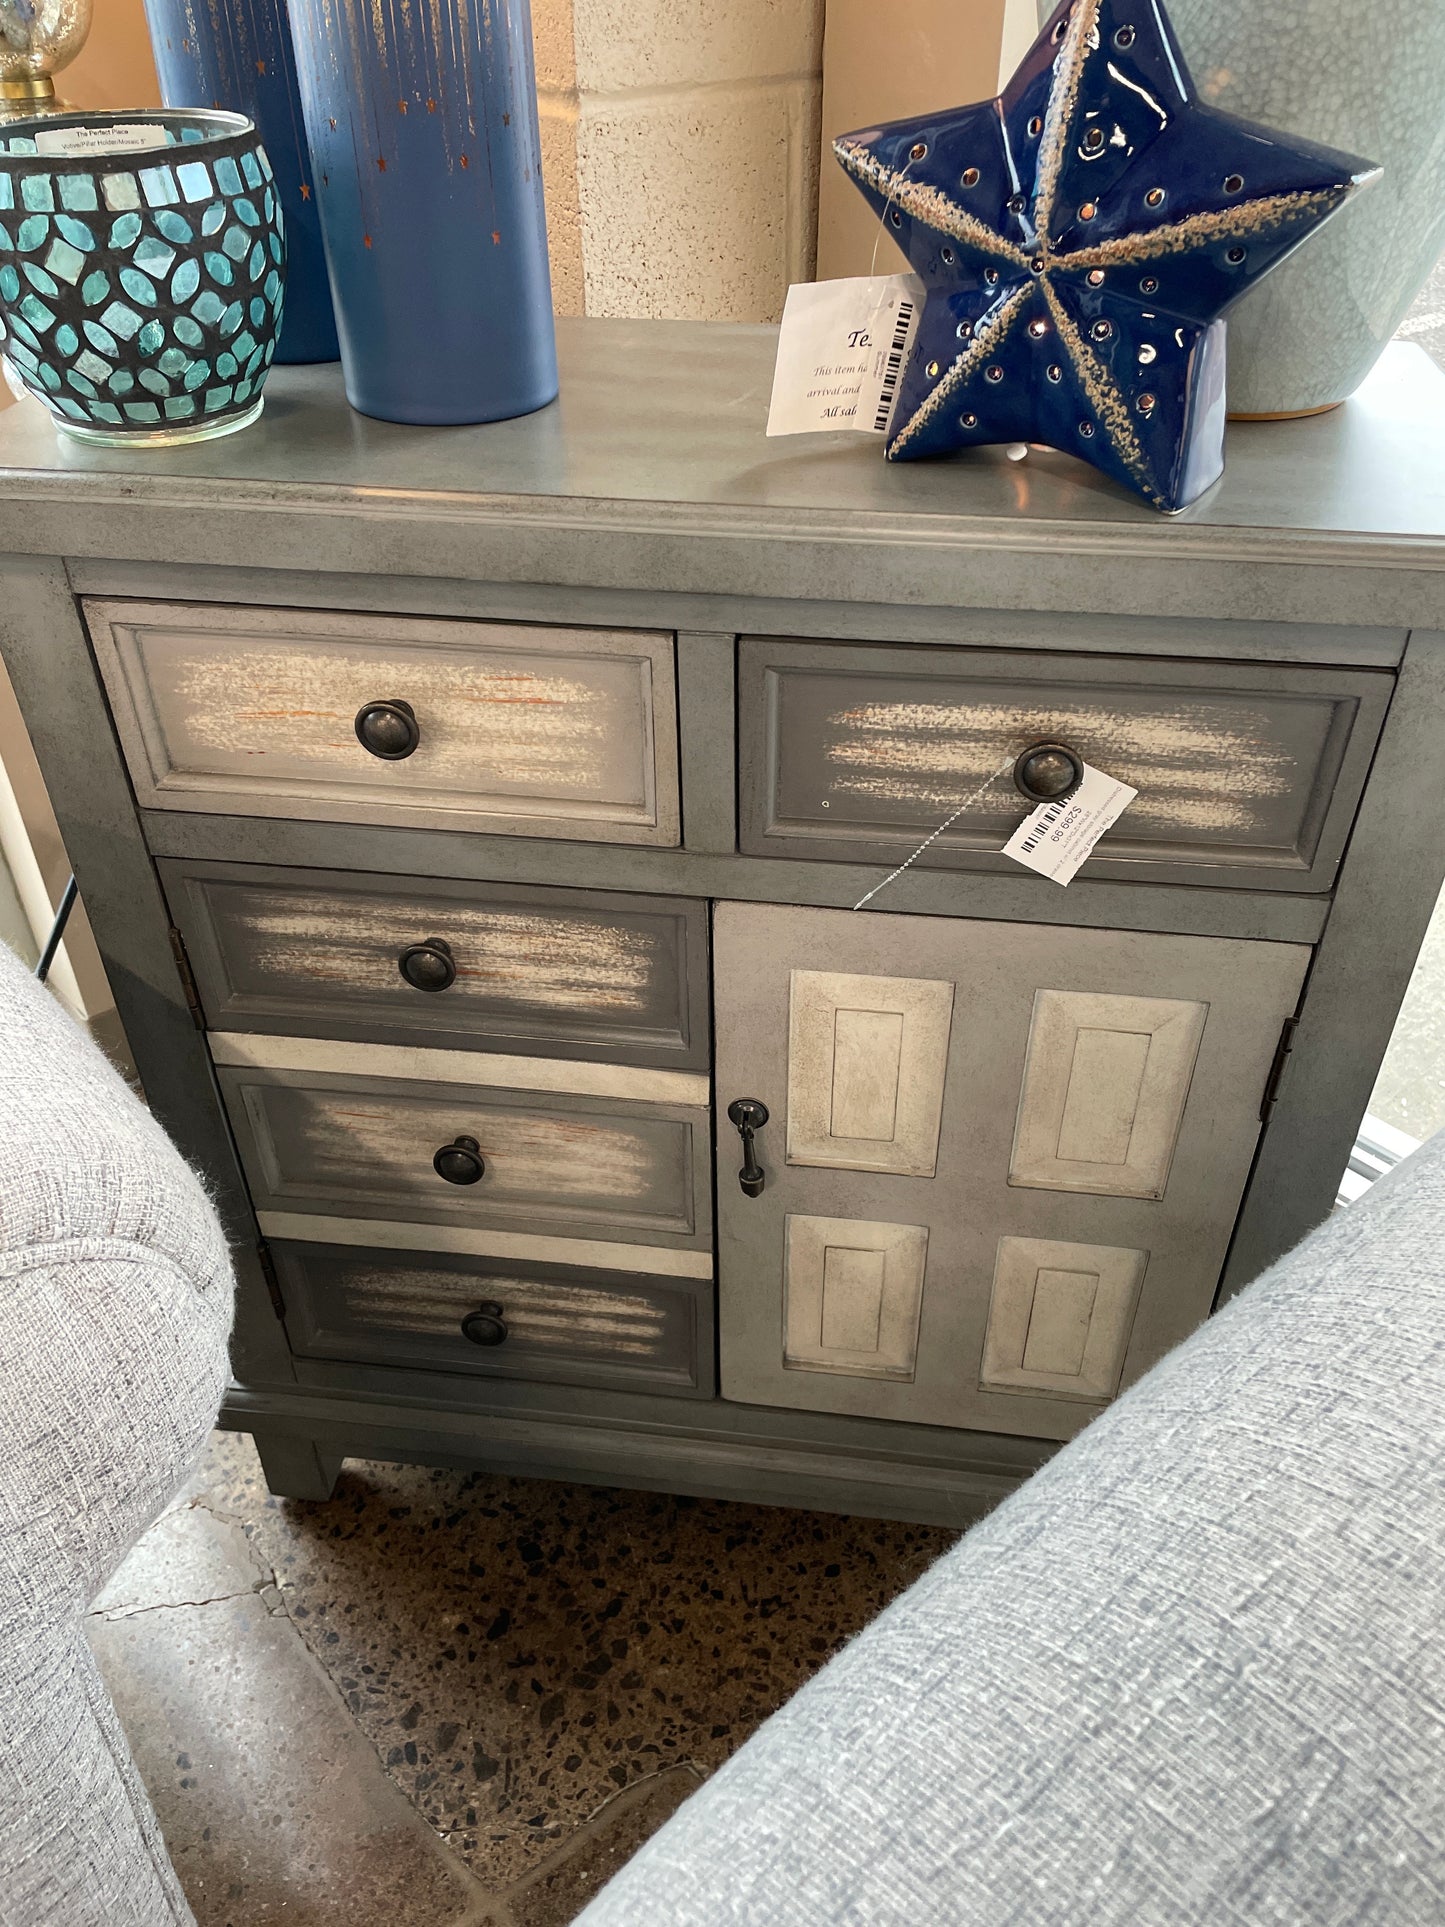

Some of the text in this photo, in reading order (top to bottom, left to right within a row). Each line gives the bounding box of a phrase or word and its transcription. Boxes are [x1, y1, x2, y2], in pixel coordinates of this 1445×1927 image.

[89, 129, 111, 137] Perfect
[847, 328, 873, 348] Te
[813, 364, 832, 377] This
[834, 365, 856, 375] item
[807, 384, 862, 398] arrival and
[820, 406, 839, 419] All
[1049, 805, 1082, 843] $299.99
[1101, 813, 1114, 827] The
[1085, 825, 1104, 847] Perfect
